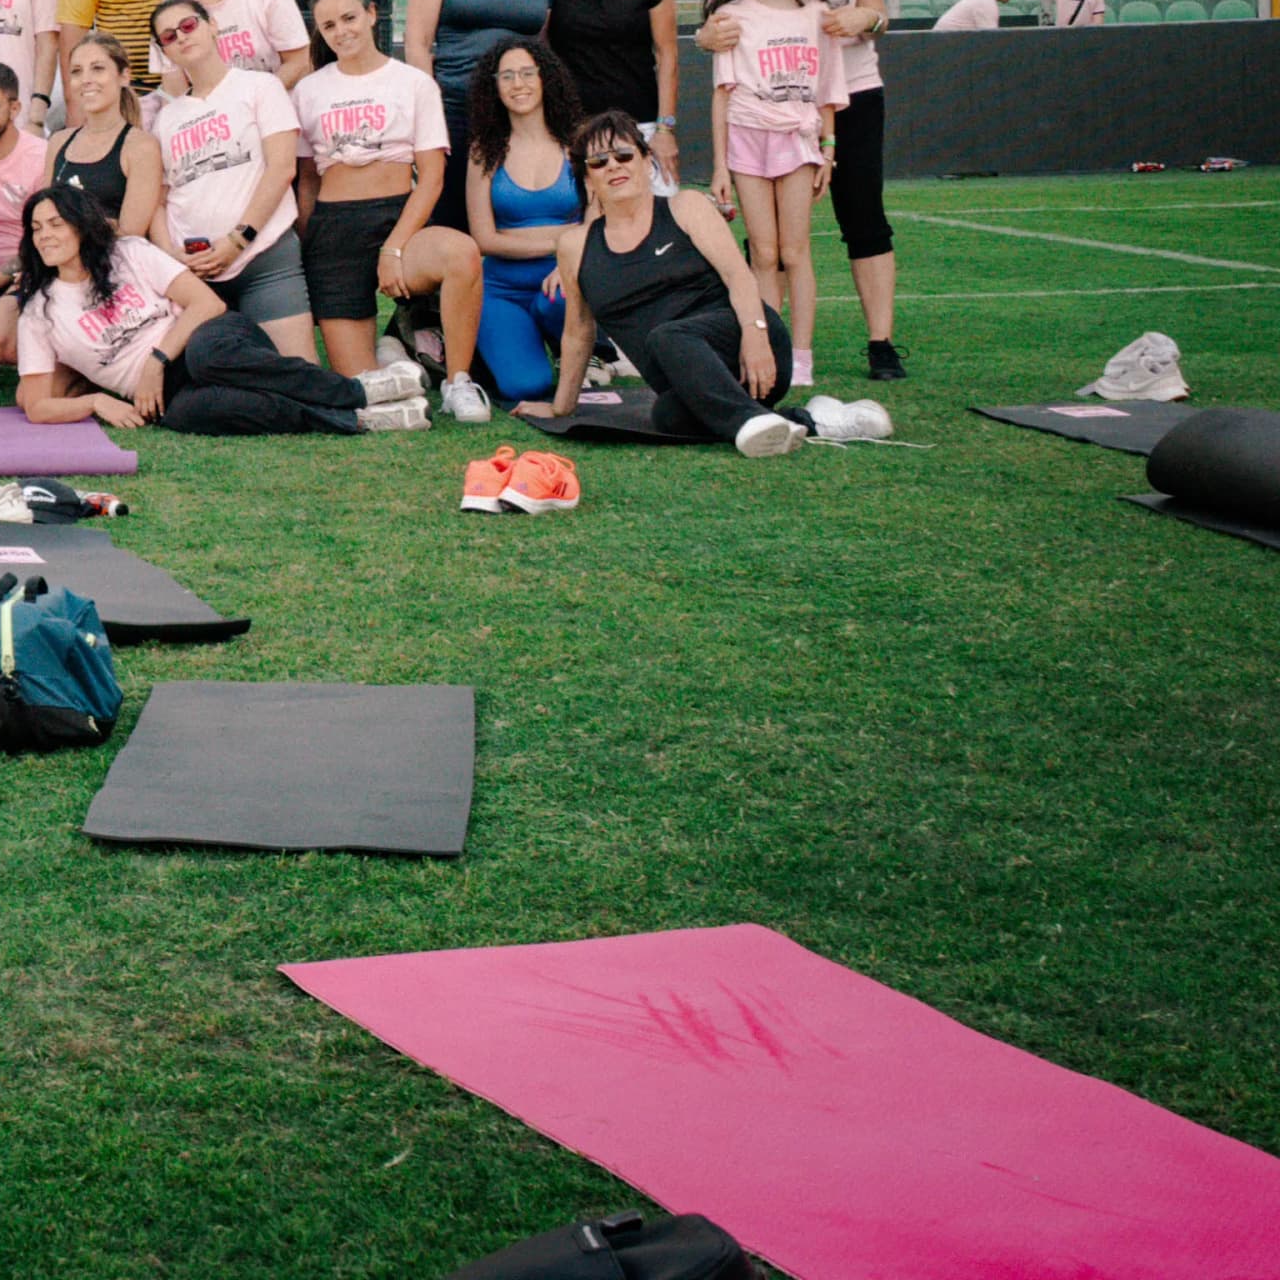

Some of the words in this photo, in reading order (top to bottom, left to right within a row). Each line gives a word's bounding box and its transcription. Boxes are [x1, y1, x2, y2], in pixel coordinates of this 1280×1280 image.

[217, 31, 256, 64] NESS
[758, 45, 819, 78] FITNESS
[170, 113, 232, 162] FITNESS
[321, 104, 386, 144] FITNESS
[78, 283, 146, 343] FITNESS
